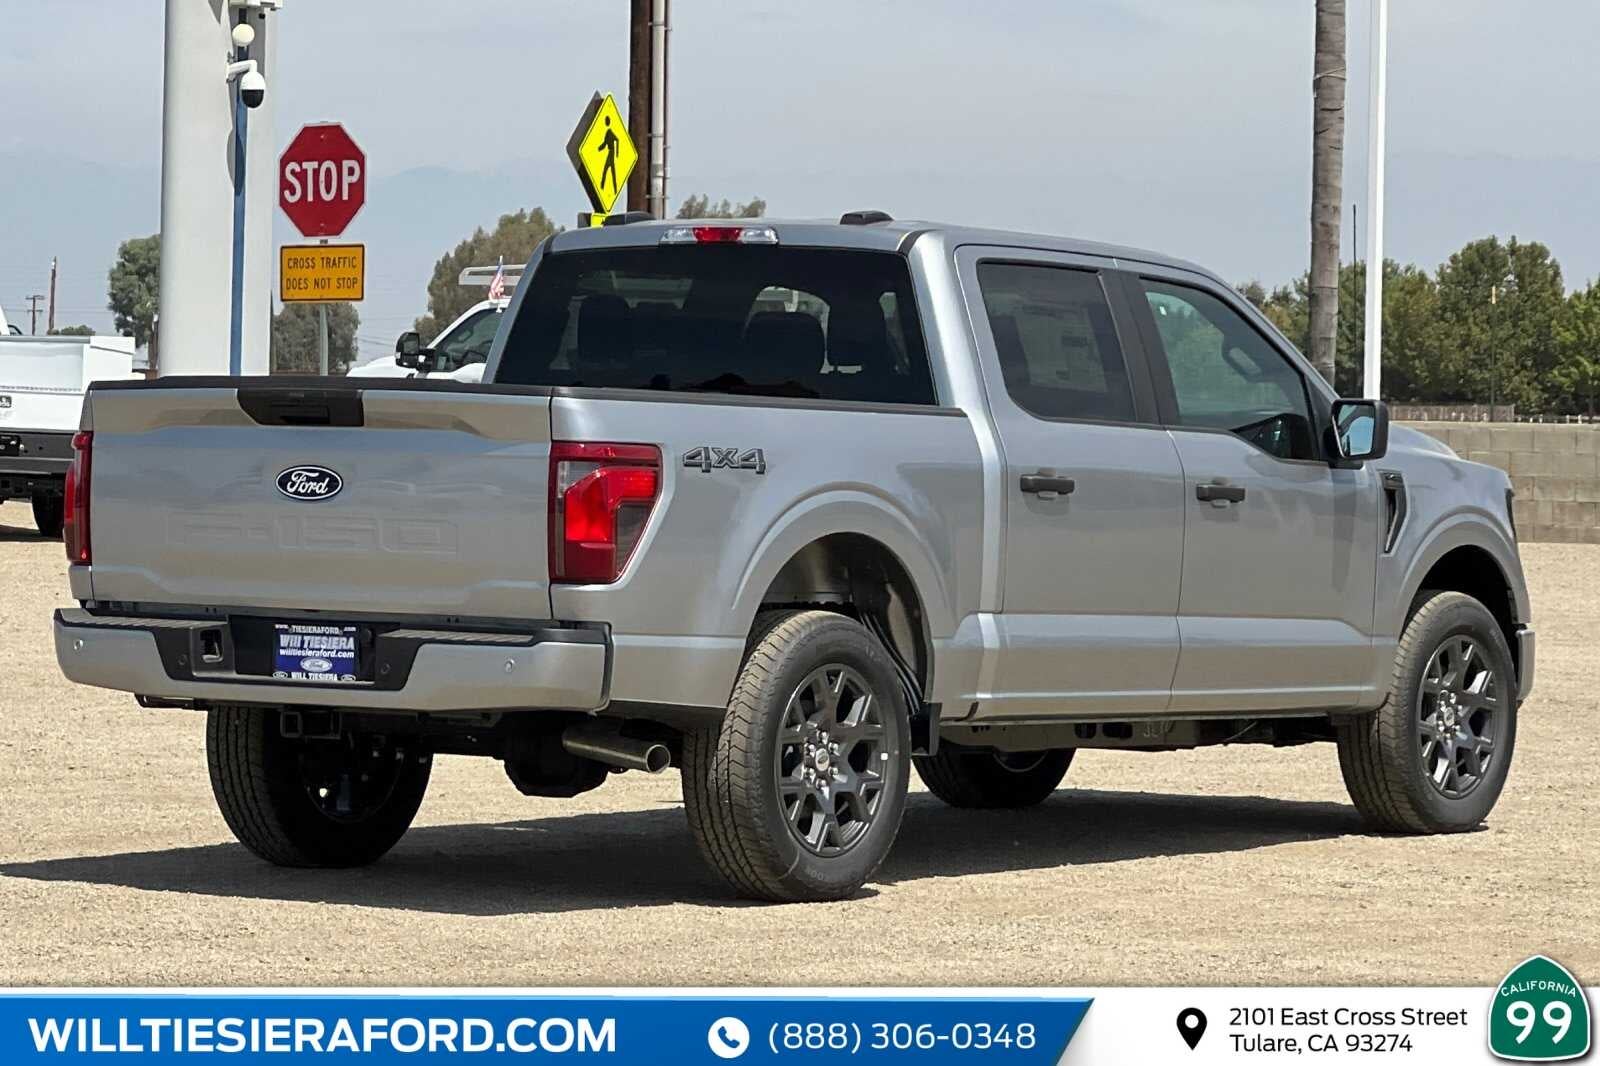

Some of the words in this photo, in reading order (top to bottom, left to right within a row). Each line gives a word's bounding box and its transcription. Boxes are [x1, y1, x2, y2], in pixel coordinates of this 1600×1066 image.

[283, 159, 361, 204] STOP
[287, 256, 316, 269] CROSS
[321, 256, 358, 269] TRAFFIC
[285, 278, 309, 290] DOES
[313, 277, 331, 290] NOT
[336, 277, 358, 289] STOP
[286, 470, 330, 494] Ford
[165, 511, 460, 554] F-150
[303, 635, 355, 650] TIESIERA
[279, 648, 355, 659] willtiesieraford.com
[291, 671, 307, 680] WILL
